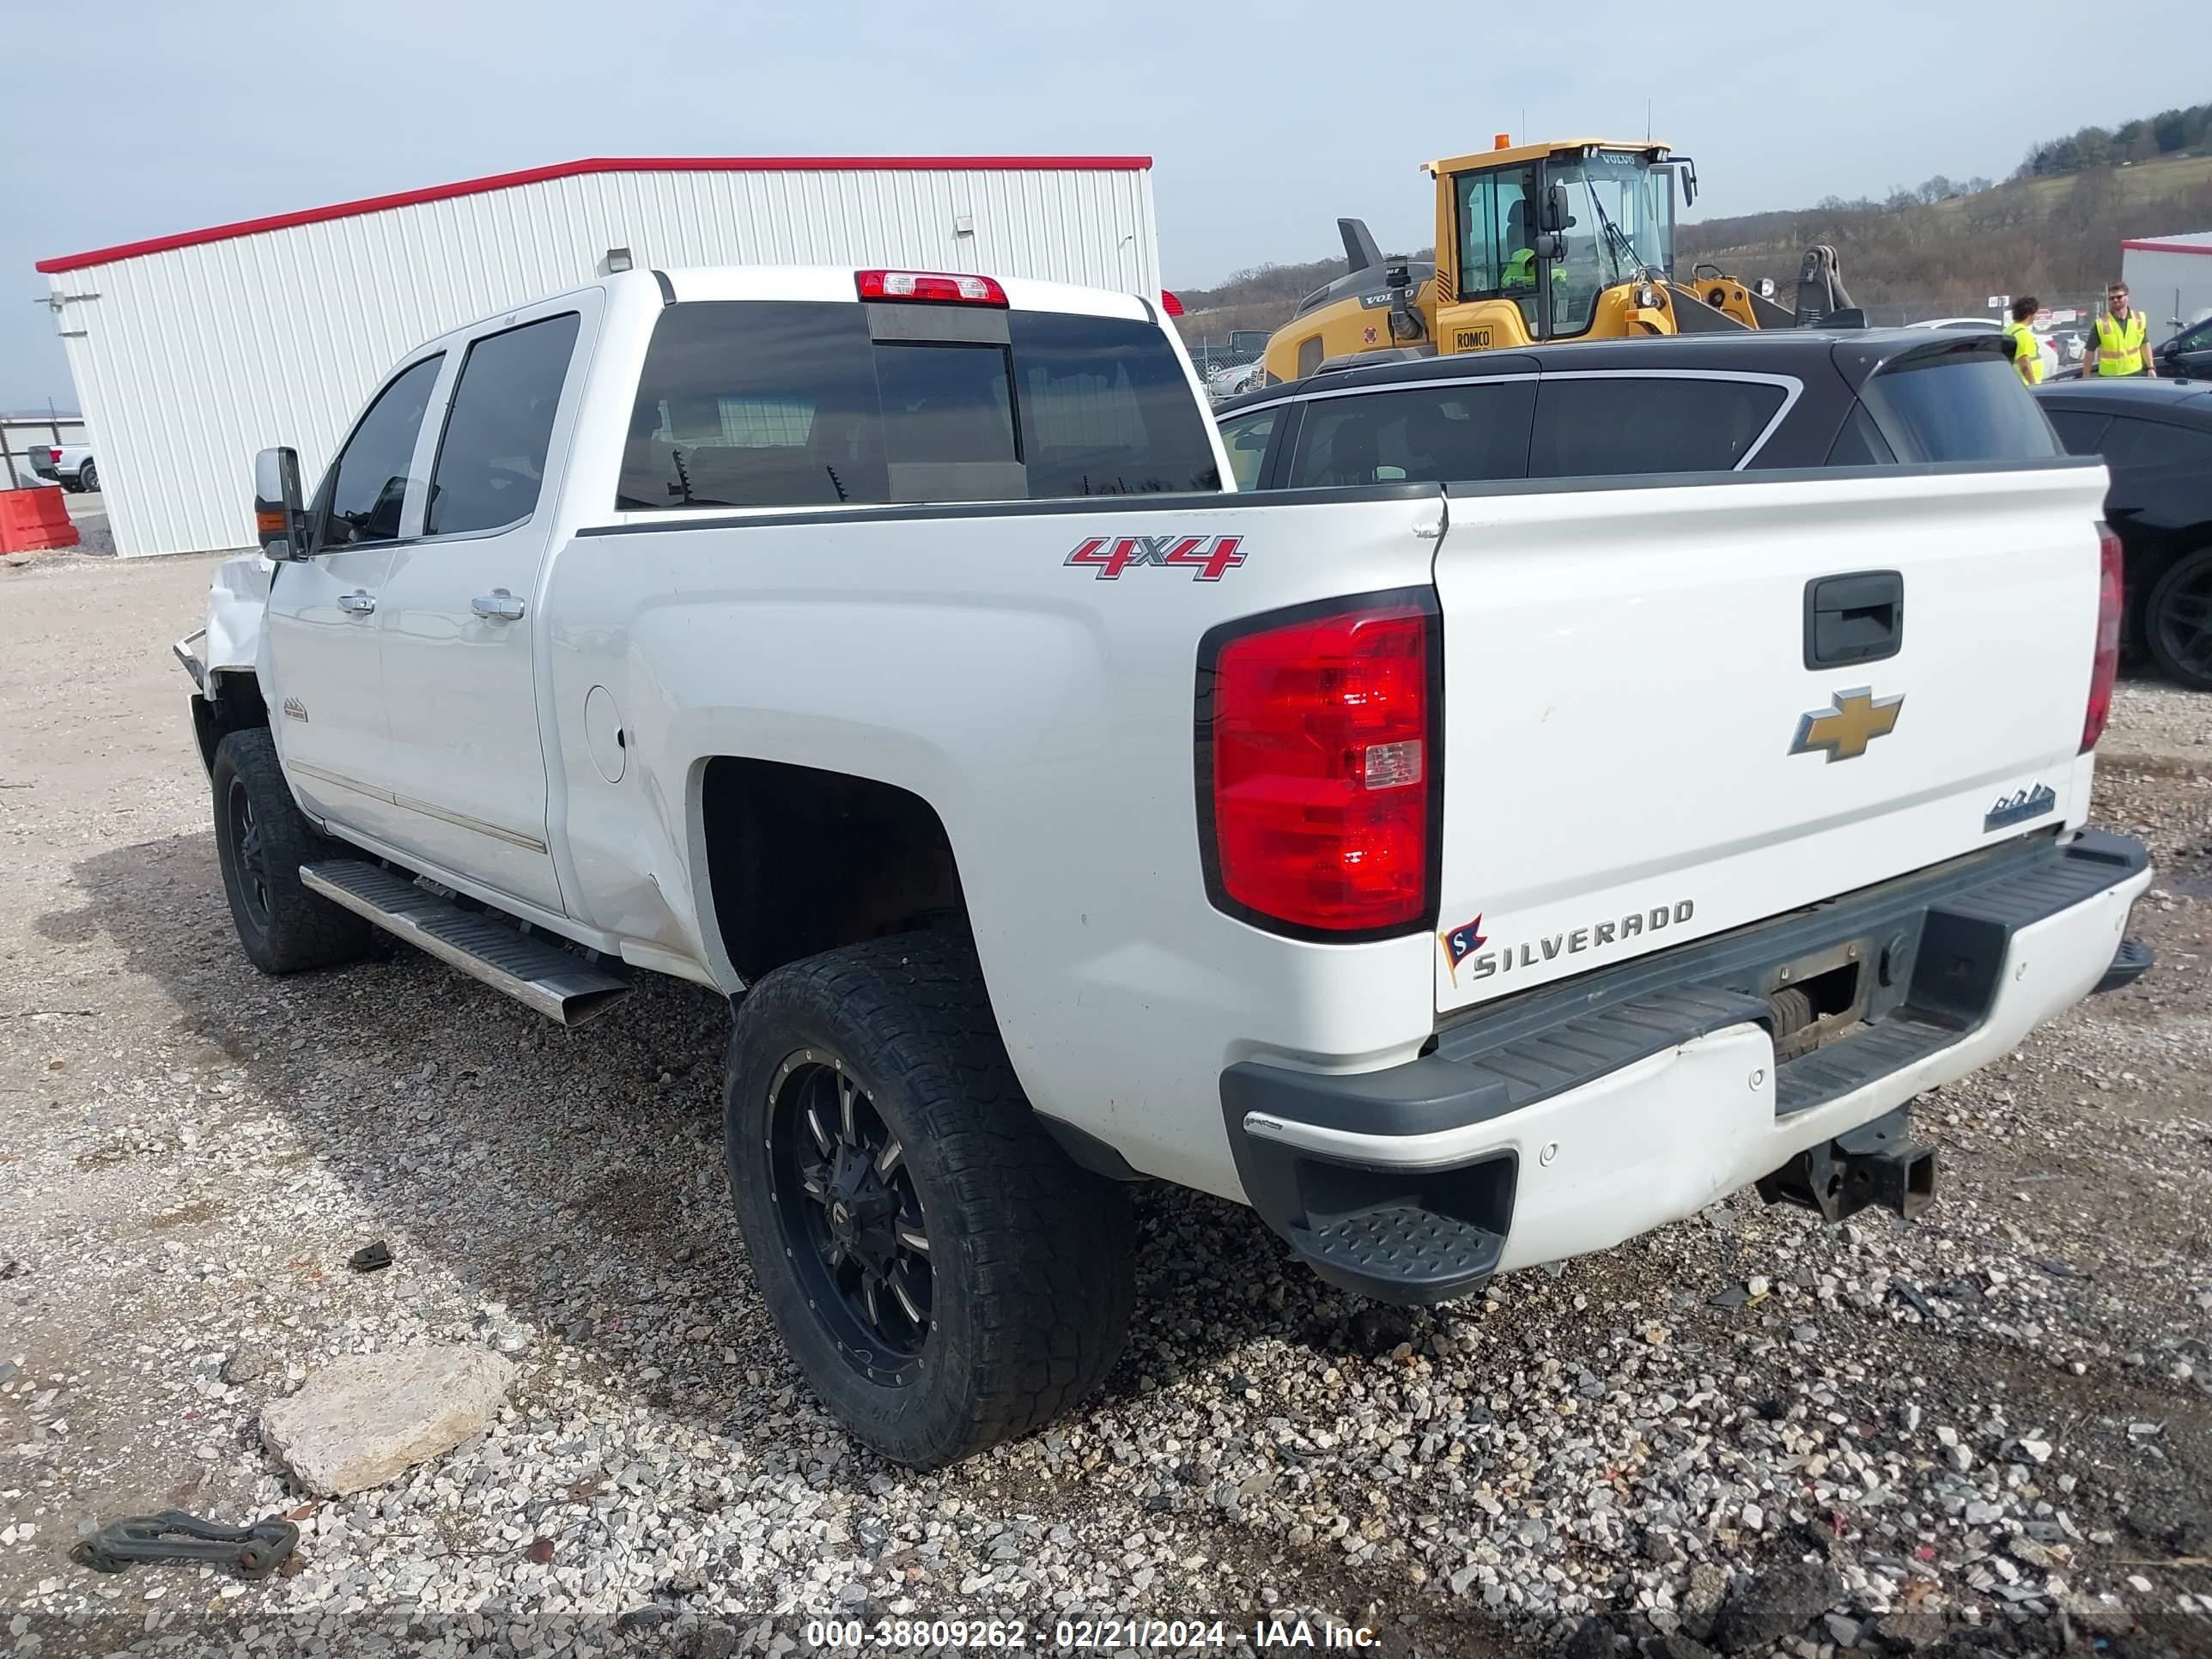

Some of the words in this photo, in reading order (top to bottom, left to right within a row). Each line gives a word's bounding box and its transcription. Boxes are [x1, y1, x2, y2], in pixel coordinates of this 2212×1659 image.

[1601, 154, 1636, 166] VOLVO
[1365, 289, 1414, 305] VOLO
[1456, 331, 1490, 349] ROMCO
[1473, 899, 1694, 981] SILVERADO
